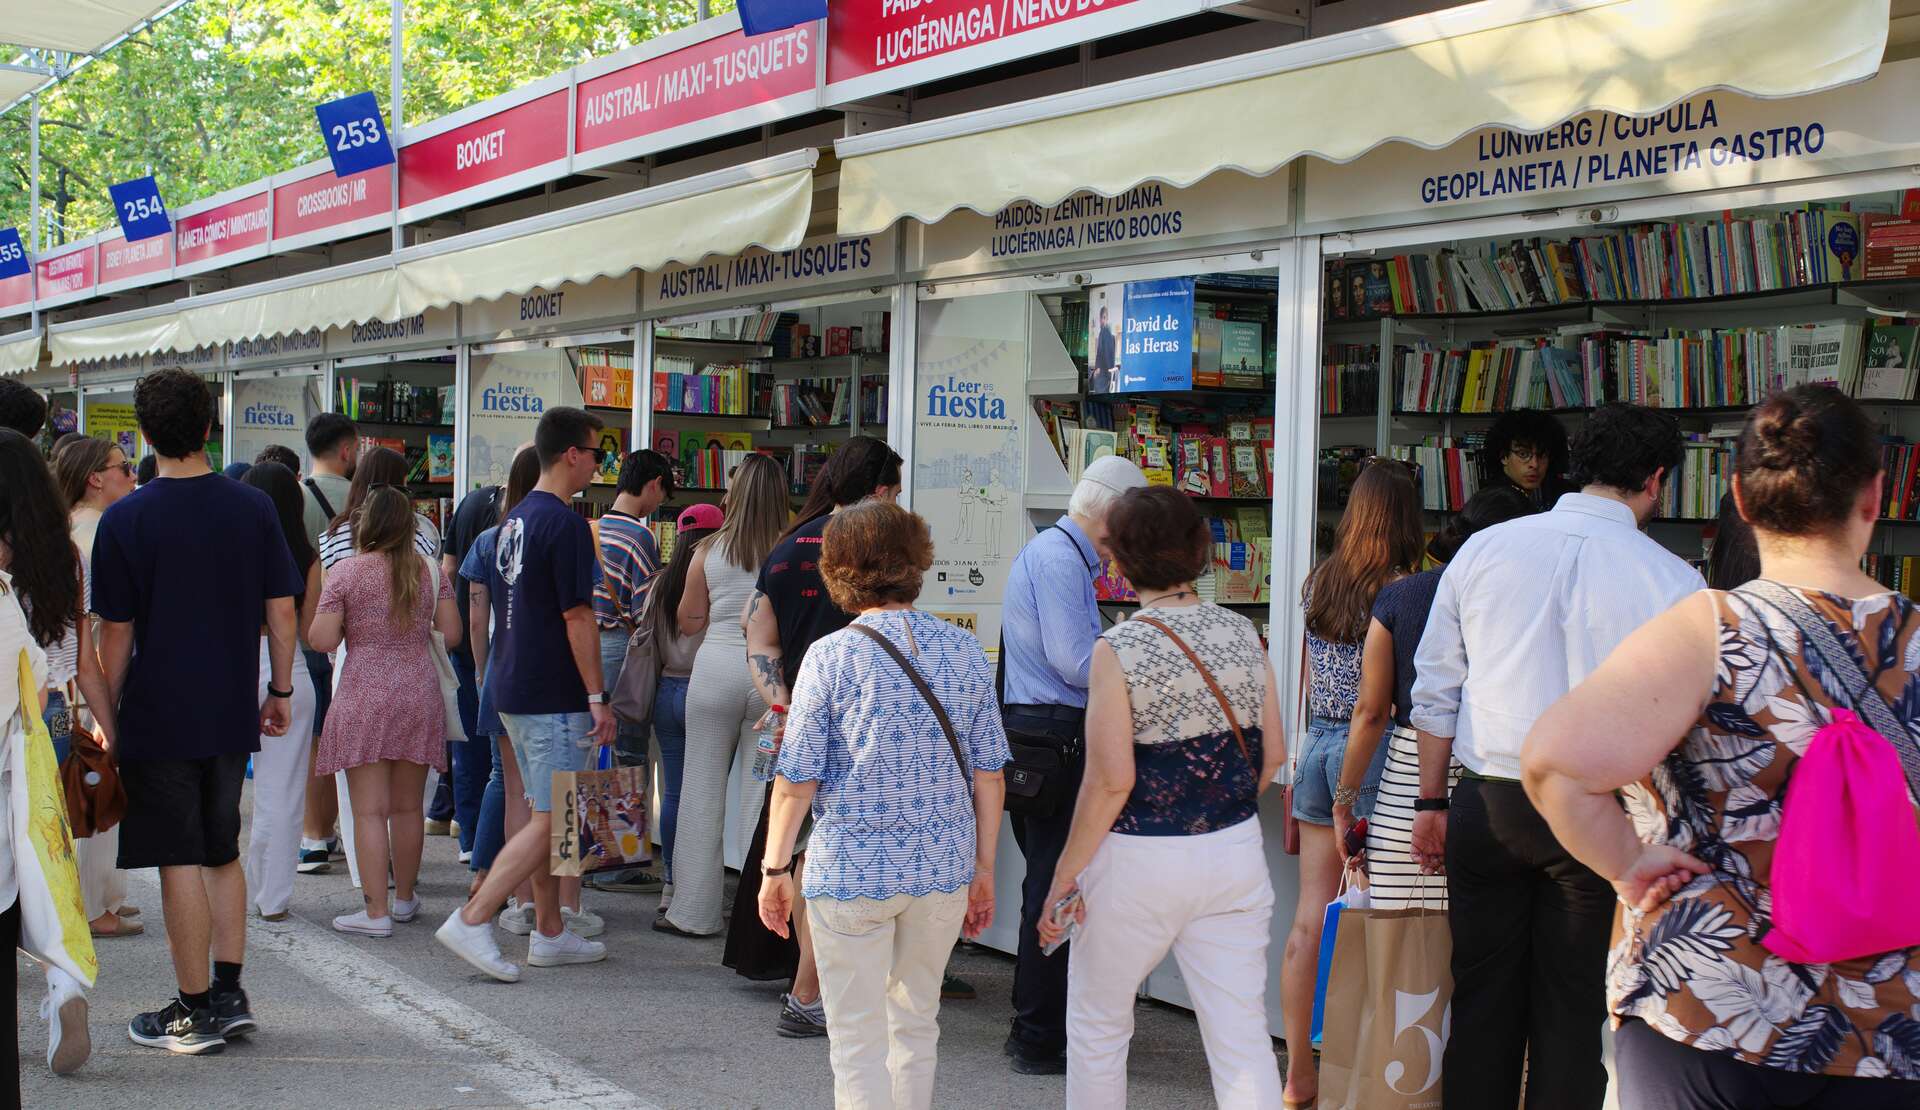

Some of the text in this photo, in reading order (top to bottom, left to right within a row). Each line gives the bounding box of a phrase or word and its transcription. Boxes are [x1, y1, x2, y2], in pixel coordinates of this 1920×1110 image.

[876, 4, 995, 66] LUCIÉRNAGA
[584, 80, 651, 128] AUSTRAL
[664, 29, 808, 105] MAXI-TUSQUETS
[332, 117, 381, 152] 253
[456, 128, 505, 171] BOOKET
[1479, 117, 1592, 161] LUNWERG
[1421, 160, 1567, 203] GEOPLANETA
[1588, 141, 1702, 183] PLANETA
[1709, 122, 1825, 166] GASTRO
[124, 195, 163, 222] 254
[297, 183, 348, 217] CROSSBOOKS
[353, 178, 367, 202] MR
[1053, 195, 1103, 222] ZENITH
[1115, 185, 1163, 213] DIANA
[177, 227, 204, 251] PLANETA
[204, 218, 227, 243] CÓMICS
[230, 207, 268, 236] MINOTAURO
[992, 225, 1075, 257] LUCIÉRNAGA
[1087, 218, 1125, 244] NEKO
[1129, 211, 1182, 239] BOOKS
[0, 243, 21, 262] 55
[660, 264, 723, 300] AUSTRAL
[735, 238, 871, 287] MAXI-TUSQUETS
[520, 291, 564, 320] BOOKET
[352, 318, 405, 343] CROSSBOOKS
[411, 314, 424, 336] MR
[1127, 314, 1179, 333] David de
[1125, 337, 1179, 355] las Heras
[481, 388, 545, 413] fiesta
[498, 382, 525, 394] Leer
[948, 376, 981, 393] Leer
[244, 407, 294, 426] fiesta
[256, 402, 278, 411] Leer
[927, 384, 1007, 420] fiesta
[165, 1016, 192, 1035] FILA
